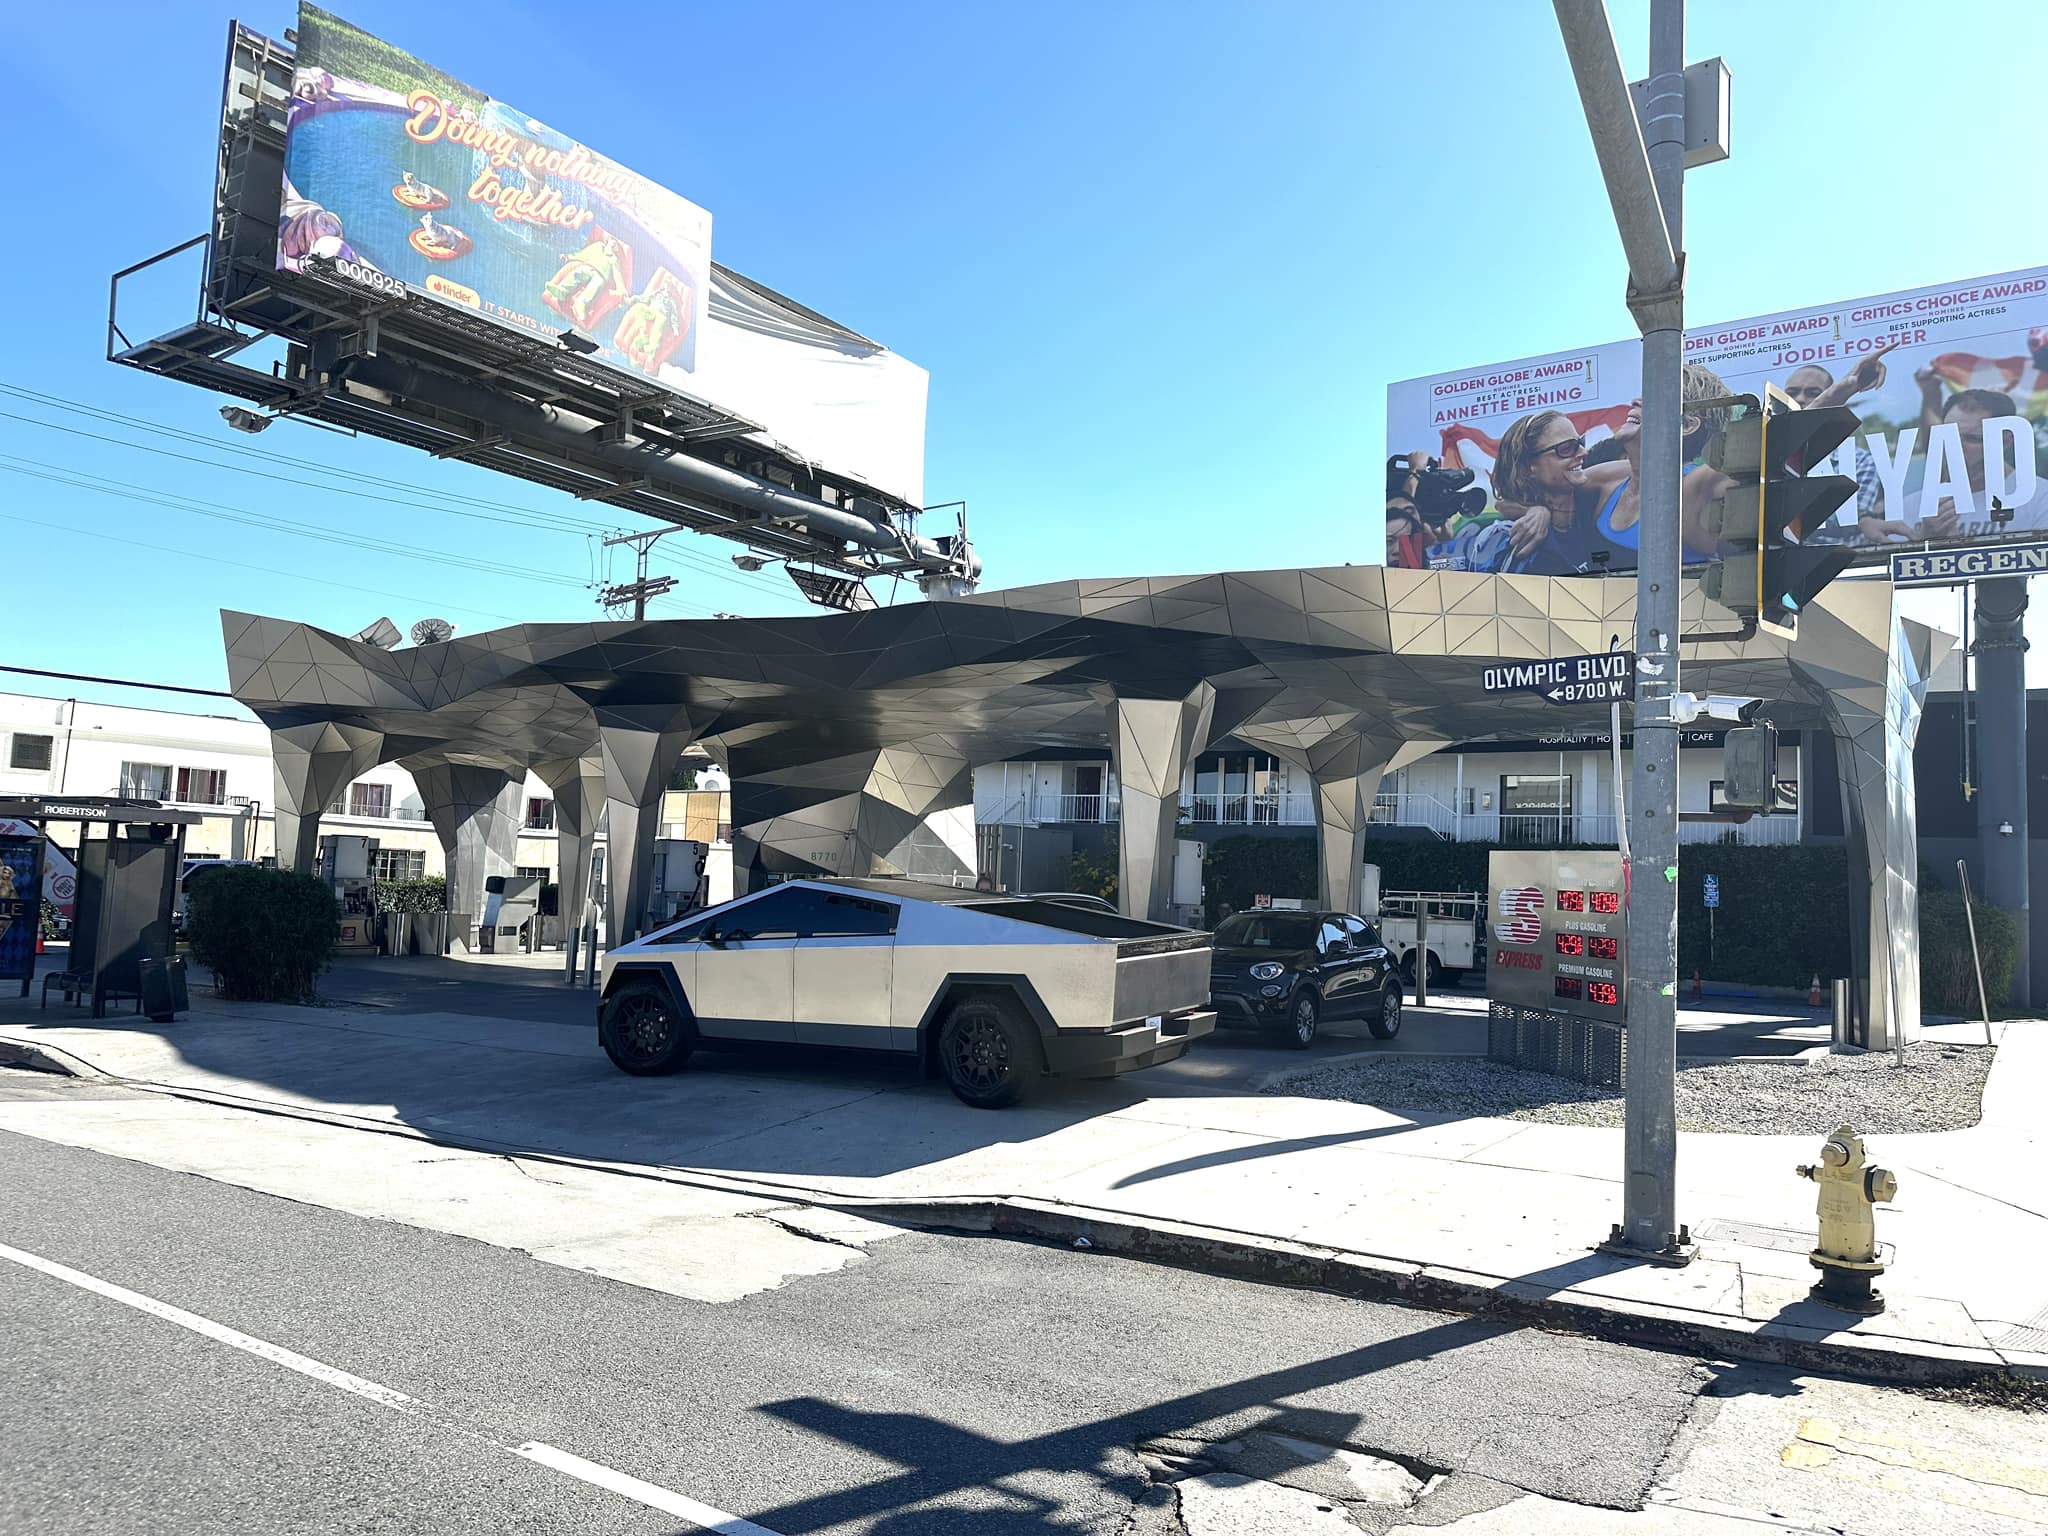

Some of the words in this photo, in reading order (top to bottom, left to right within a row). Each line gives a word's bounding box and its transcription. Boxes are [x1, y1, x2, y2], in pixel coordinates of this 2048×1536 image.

[405, 89, 521, 168] Doing
[525, 144, 638, 207] nothing
[468, 166, 593, 229] together
[336, 257, 406, 298] 000925
[442, 283, 473, 304] tinder
[1851, 302, 1913, 323] CRITICS
[1916, 290, 1979, 312] CHOICE
[1982, 279, 2046, 300] AWARD
[485, 301, 496, 312] IT
[498, 307, 537, 330] STARTS
[540, 324, 562, 339] WIT
[1717, 326, 1767, 346] GLOBE
[1771, 315, 1830, 336] AWARD
[1889, 321, 1909, 332] BEST
[1911, 312, 1966, 329] SUPPORTING
[1967, 306, 2007, 320] ACTRESS
[1688, 356, 1706, 366] BEST
[1708, 347, 1756, 362] SUPPORTING
[1757, 342, 1792, 354] ACTRESS
[1772, 343, 1836, 367] JODIE
[1844, 329, 1927, 355] FOSTER
[1434, 378, 1485, 397] GOLDEN
[1488, 370, 1530, 387] GLOBE
[1534, 361, 1583, 379] AWARD
[1434, 400, 1510, 423] ANNETTE
[1516, 387, 1582, 409] BENING
[1476, 394, 1497, 403] BEST
[1484, 662, 1567, 690] OLYMPIC
[1577, 656, 1631, 681] BLVD.
[1565, 682, 1606, 701] 8700
[1609, 681, 1627, 697] W.
[1539, 735, 1588, 743] HOSPITALITY
[1692, 733, 1714, 741] CAFE
[45, 805, 107, 817] ROBERTSON
[361, 838, 367, 849] 7
[693, 843, 699, 855] 5
[1197, 843, 1202, 858] 3
[1565, 920, 1579, 930] PLUS
[1580, 921, 1607, 933] GASOLINE
[1496, 950, 1543, 970] EXPRESS
[1558, 963, 1584, 975] PREMIUM
[1585, 966, 1613, 979] GASOLINE
